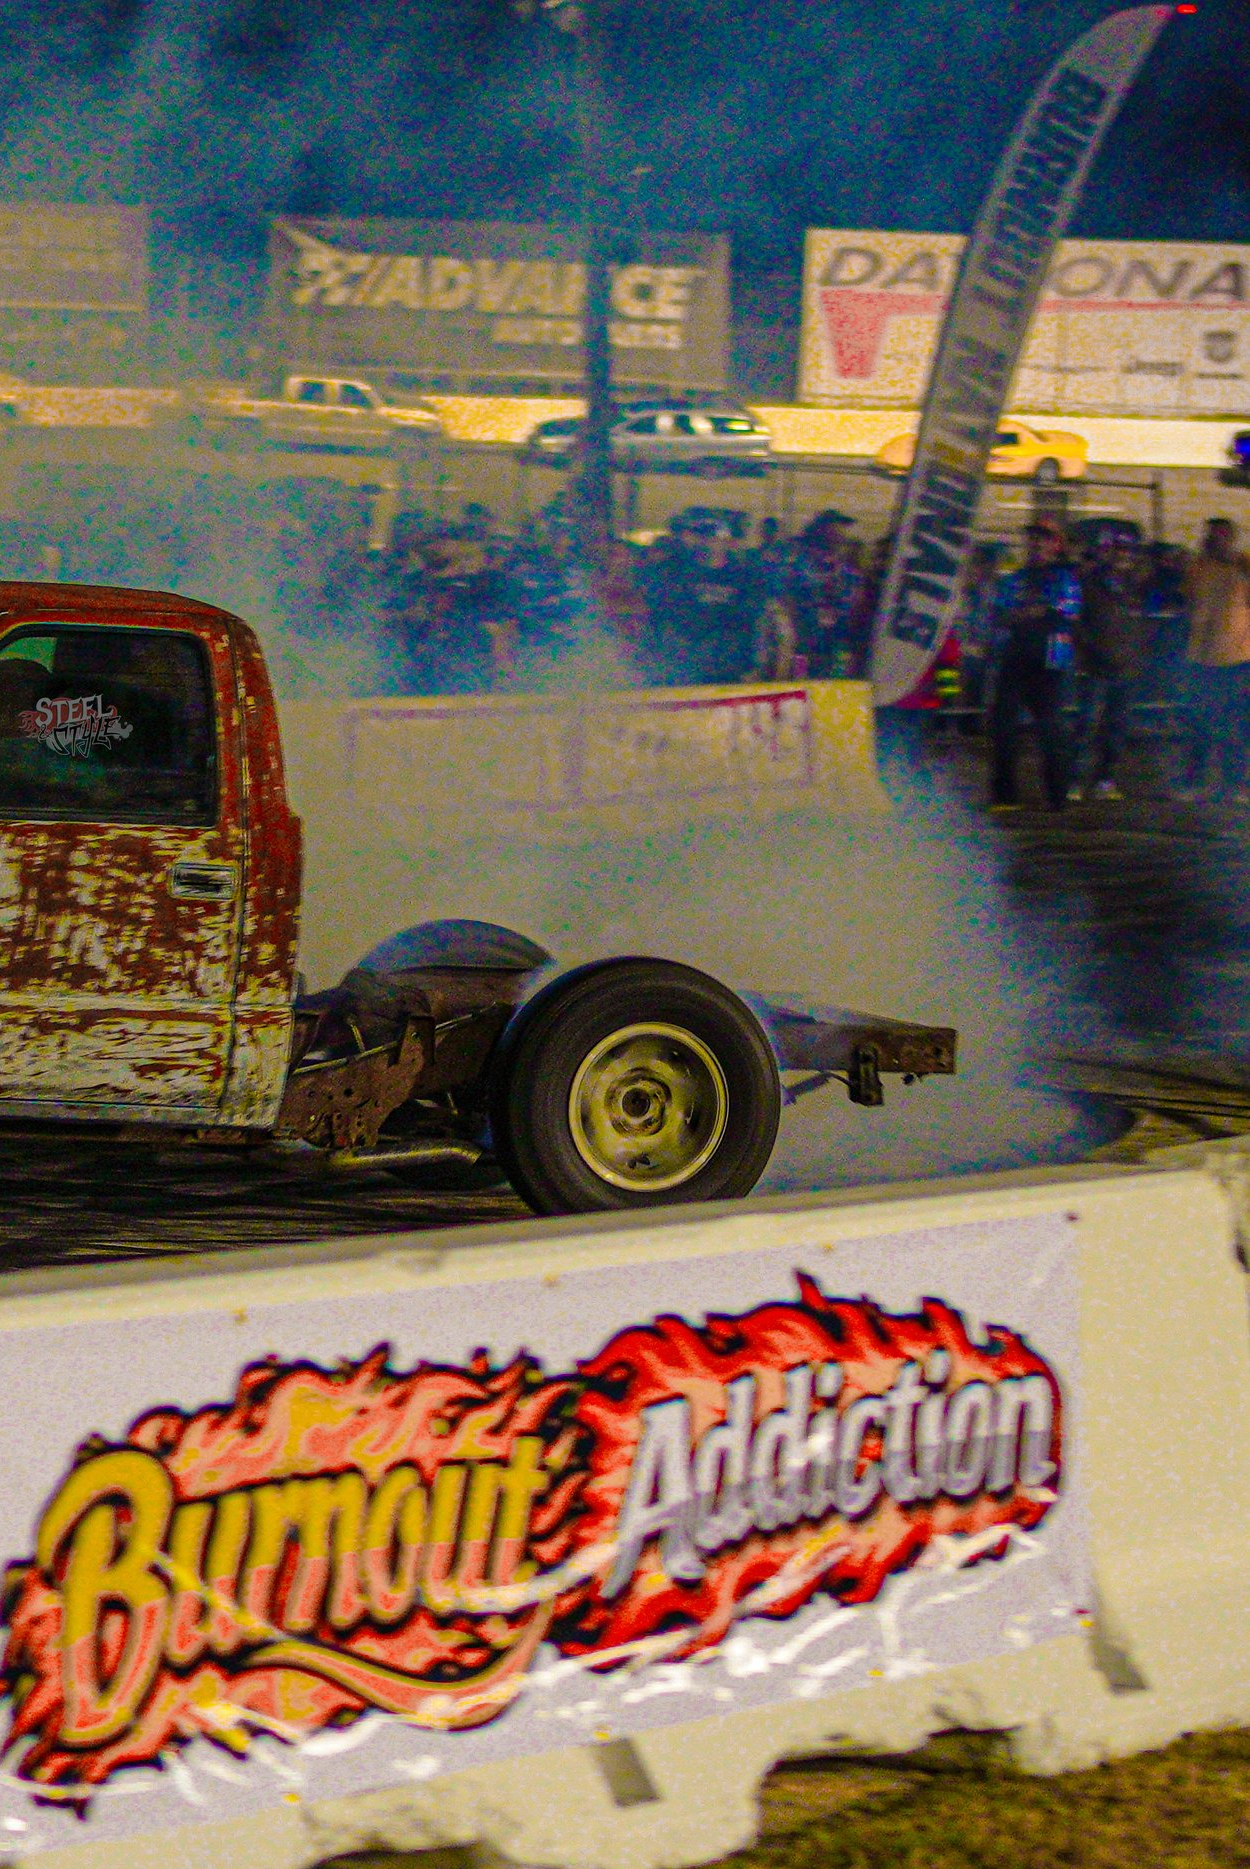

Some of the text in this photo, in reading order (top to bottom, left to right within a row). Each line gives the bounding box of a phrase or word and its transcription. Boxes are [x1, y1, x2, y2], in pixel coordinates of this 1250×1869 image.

[820, 246, 1246, 300] DAONA
[969, 66, 1107, 314] BURNOUT
[38, 1352, 1056, 1746] Burnout Addiction
